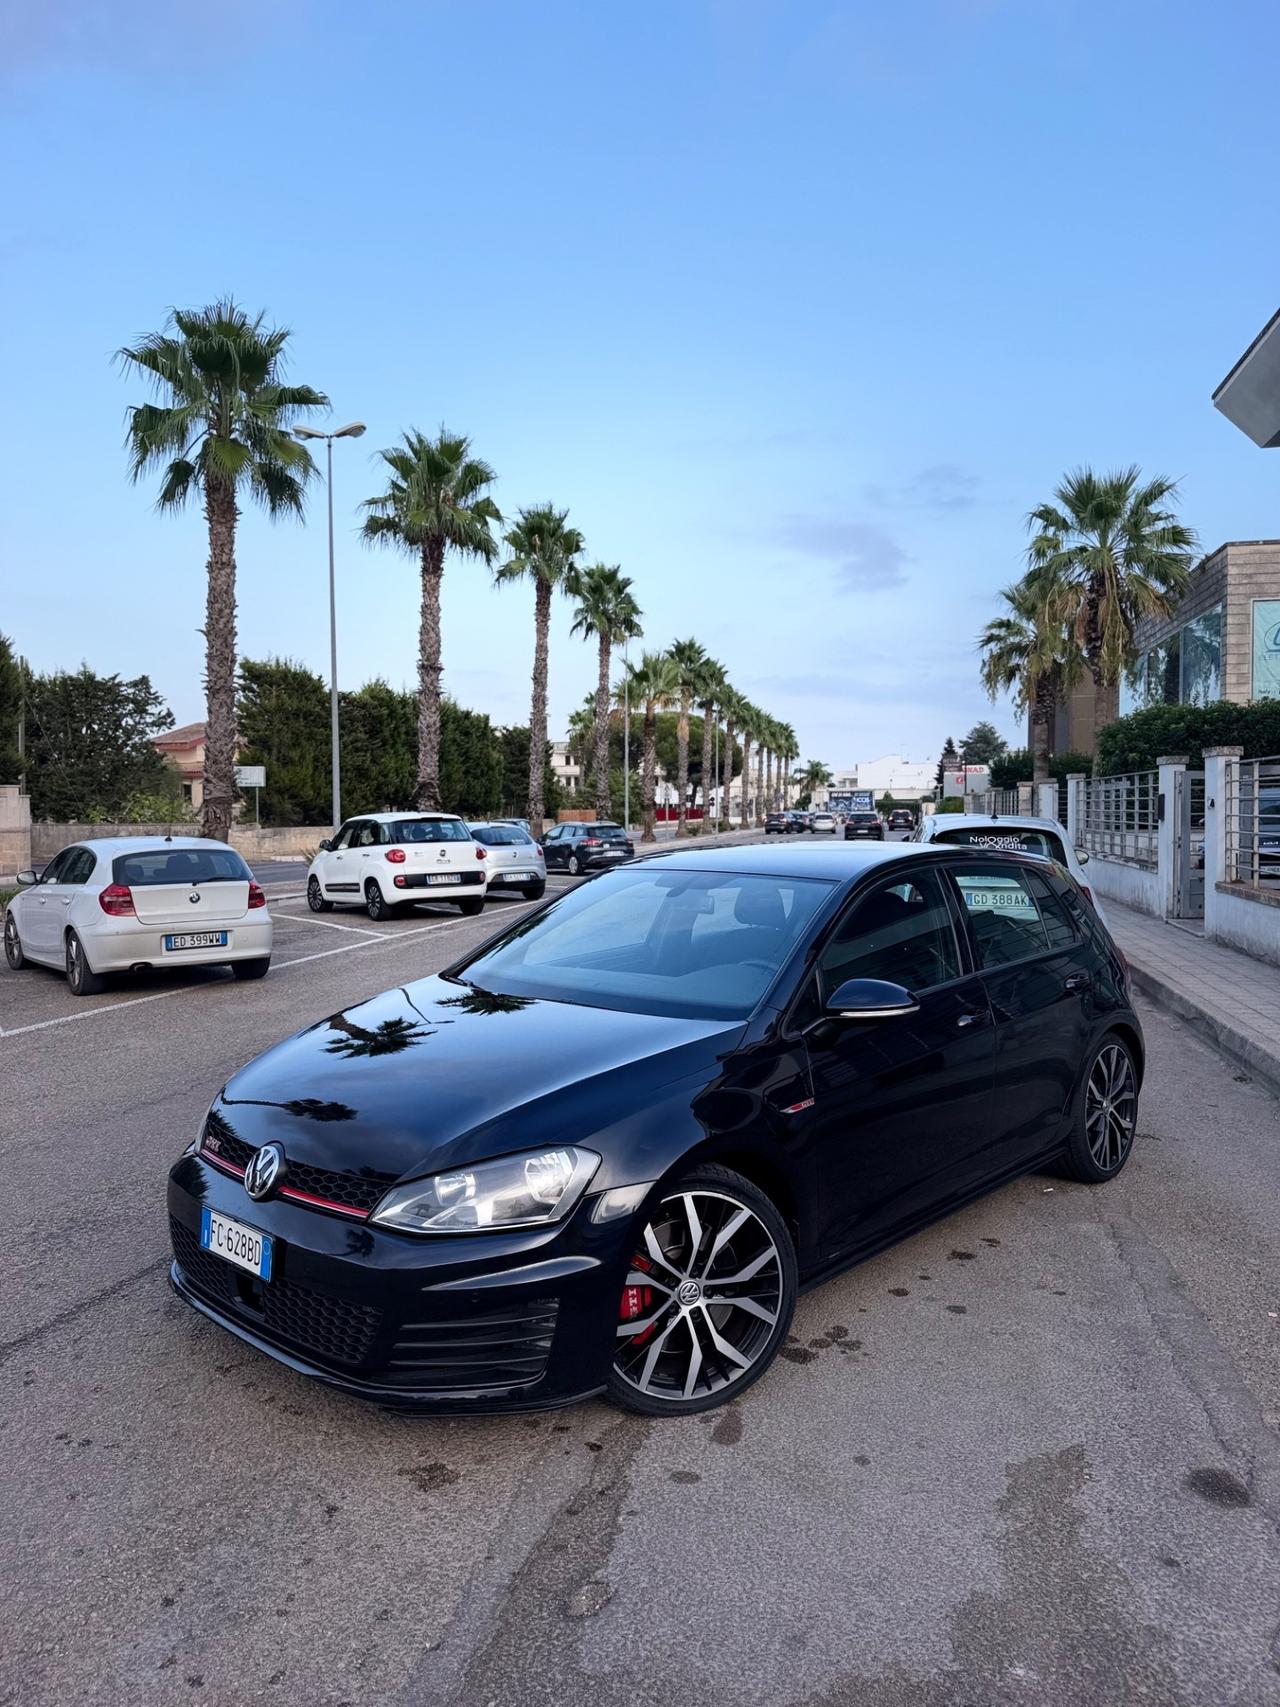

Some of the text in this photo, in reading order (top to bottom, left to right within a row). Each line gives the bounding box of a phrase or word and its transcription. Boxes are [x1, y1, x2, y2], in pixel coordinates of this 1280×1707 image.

[974, 894, 1027, 906] GD 388AK
[173, 933, 221, 948] ED 399WW
[211, 1219, 261, 1266] FC 628BD
